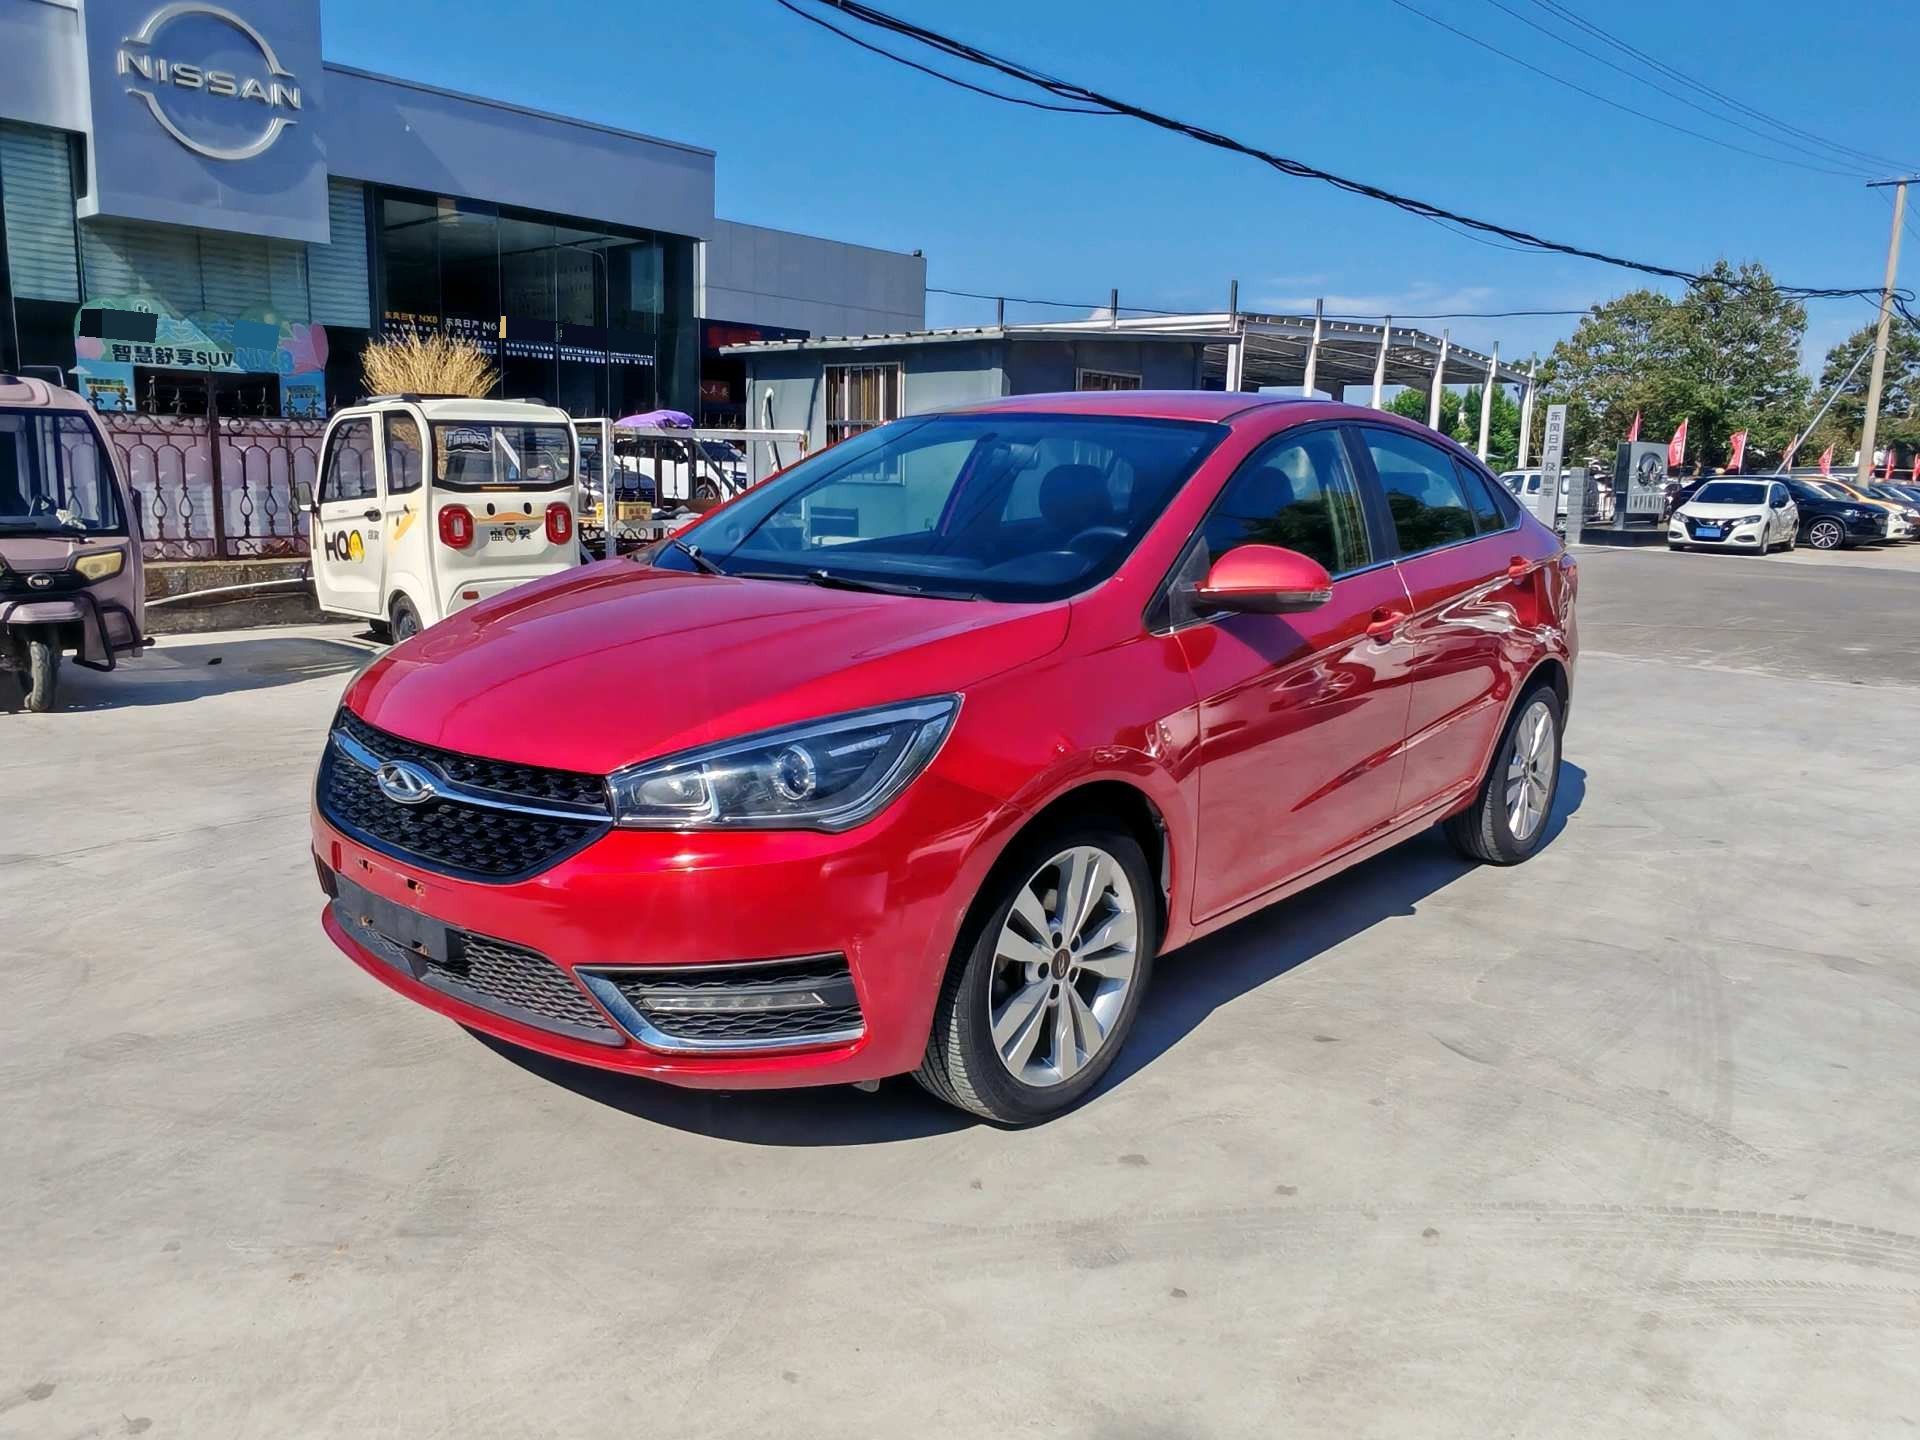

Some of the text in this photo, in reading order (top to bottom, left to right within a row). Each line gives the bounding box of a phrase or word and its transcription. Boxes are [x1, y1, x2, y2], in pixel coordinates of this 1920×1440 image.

[117, 49, 302, 110] NISSAN
[445, 317, 480, 329] 东风日产
[482, 321, 497, 331] N6
[111, 343, 234, 368] 智慧舒享SUV
